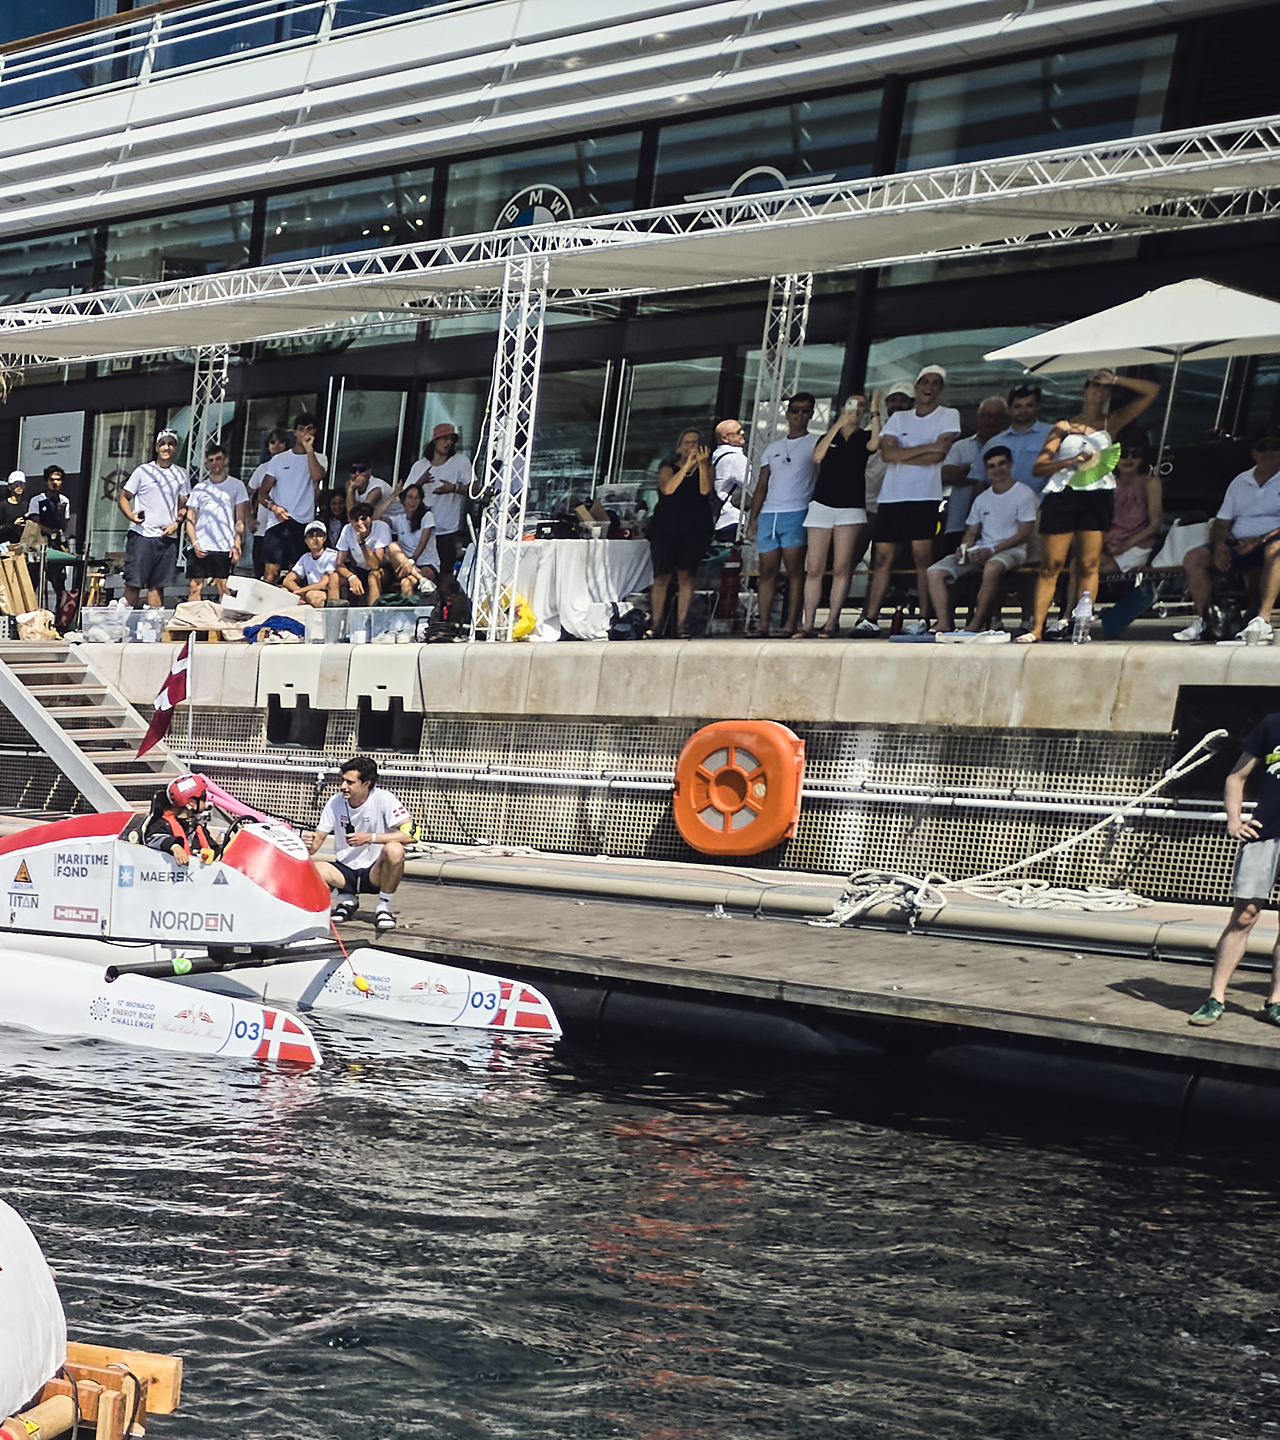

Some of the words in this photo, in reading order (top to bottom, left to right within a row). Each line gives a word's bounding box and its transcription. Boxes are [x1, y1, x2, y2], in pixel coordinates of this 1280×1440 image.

[504, 189, 566, 223] BMW
[57, 853, 109, 865] MARITIME
[140, 871, 194, 882] MAERSK
[125, 1000, 156, 1011] MONACO
[471, 991, 496, 1010] 03
[112, 1007, 137, 1018] ENERGY
[139, 1012, 157, 1020] BOAT
[110, 1016, 155, 1030] CHALLENGE
[234, 1020, 260, 1041] 03
